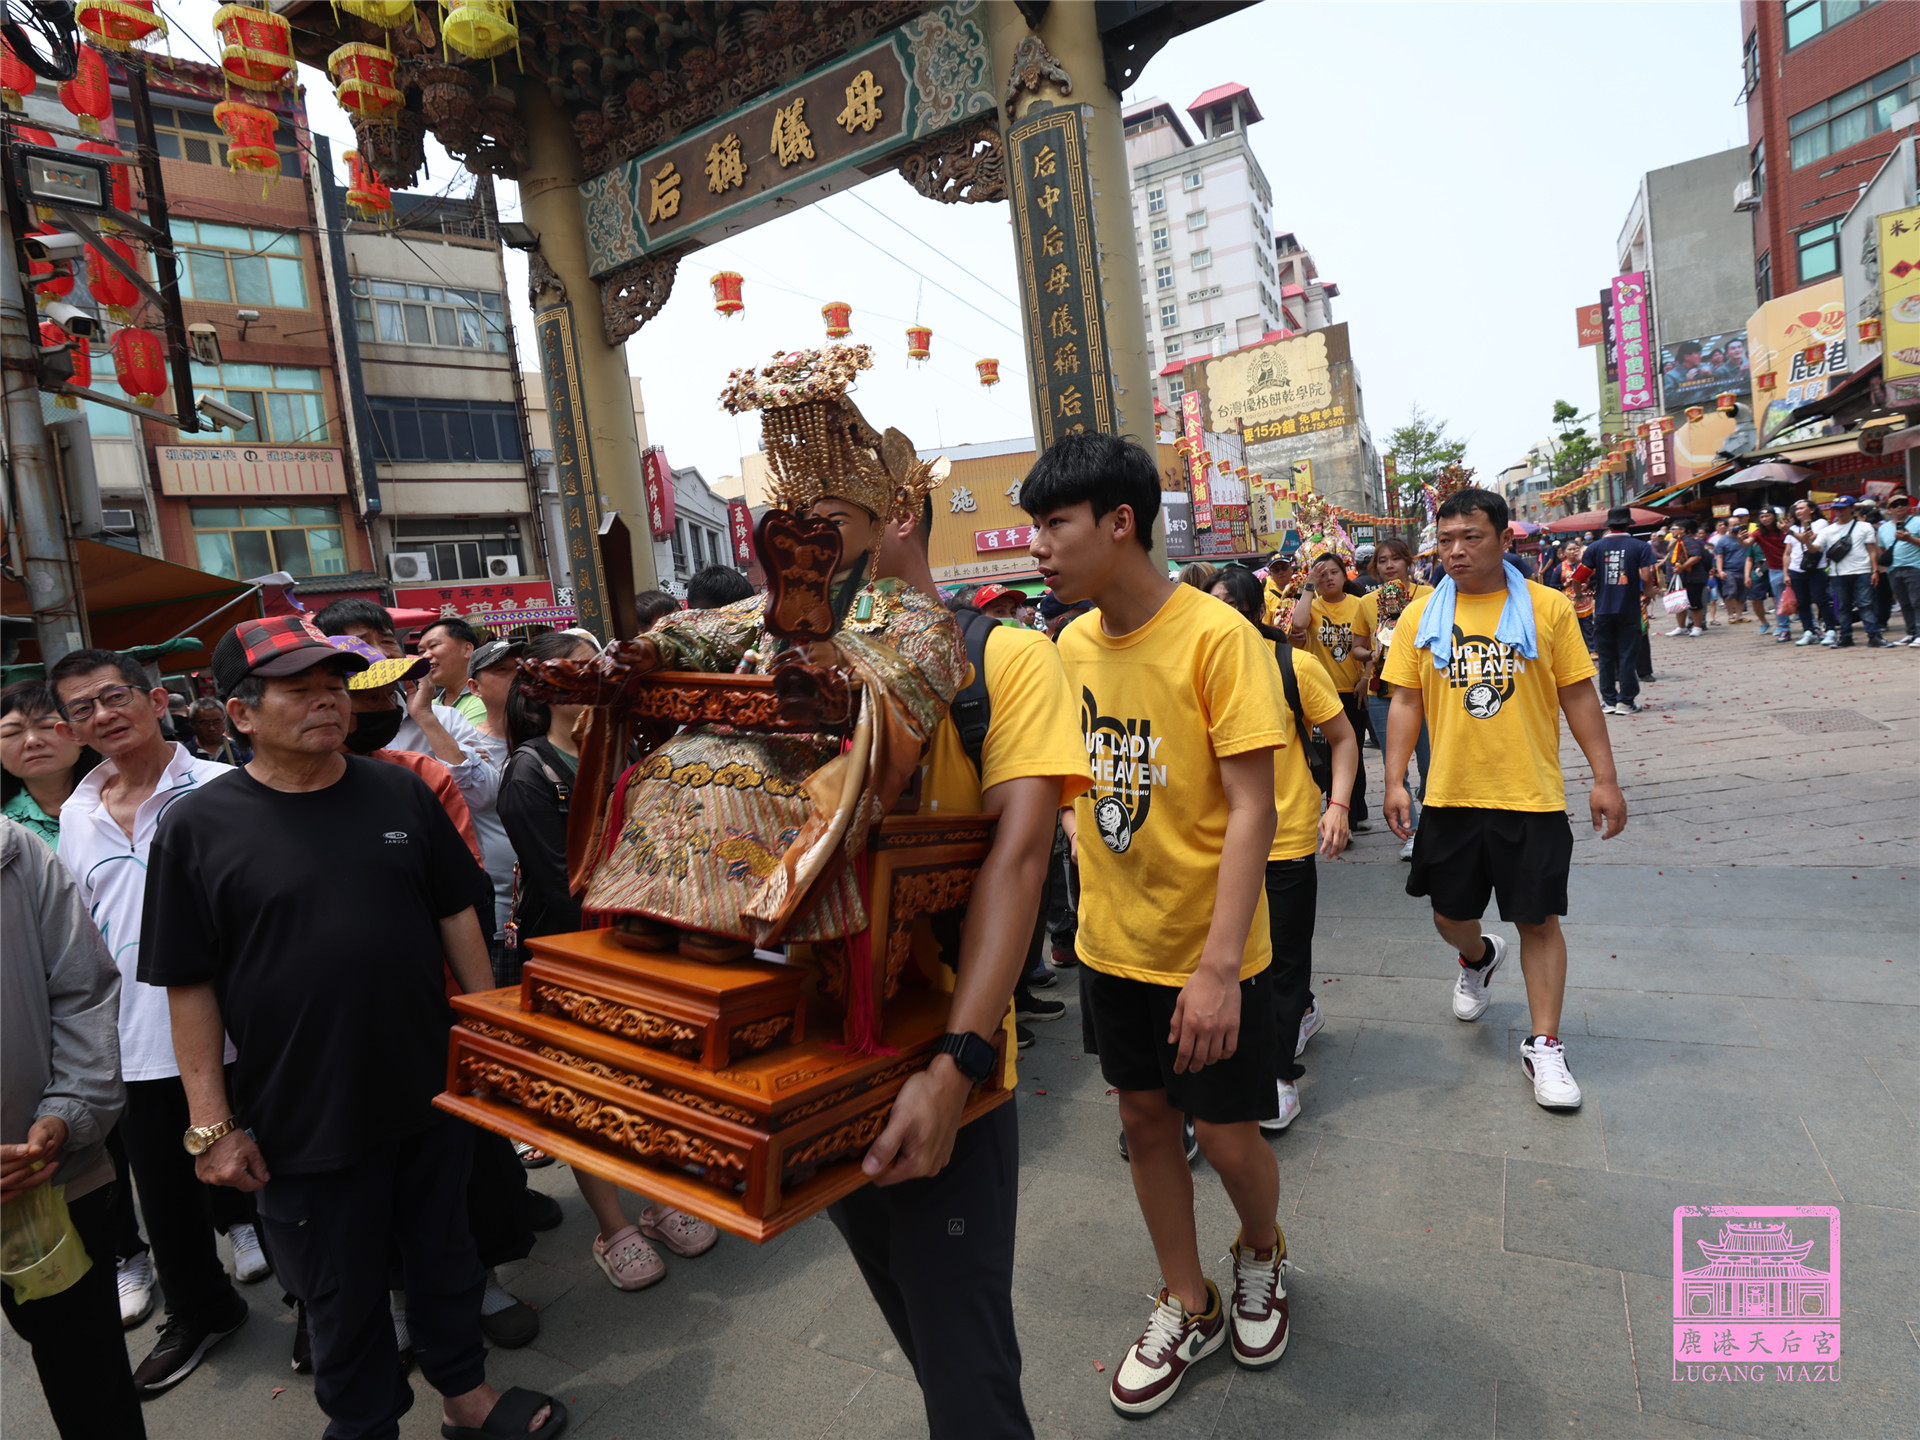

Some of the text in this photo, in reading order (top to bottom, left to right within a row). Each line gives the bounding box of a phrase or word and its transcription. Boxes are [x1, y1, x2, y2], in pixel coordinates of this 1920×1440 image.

[1787, 338, 1848, 384] 鹿港
[1217, 382, 1326, 419] 台灣優格餅乾學院
[1785, 380, 1830, 405] 蚵仔
[1298, 405, 1345, 425] 免費參觀
[1300, 417, 1346, 434] 04-758-9501
[166, 448, 238, 462] 祖傳第四代
[437, 586, 515, 600] 百年老店
[1452, 645, 1475, 660] UR
[1438, 659, 1526, 679] OF HEAVEN
[1083, 732, 1163, 759] UR LADY
[1091, 758, 1168, 787] HEAVEN
